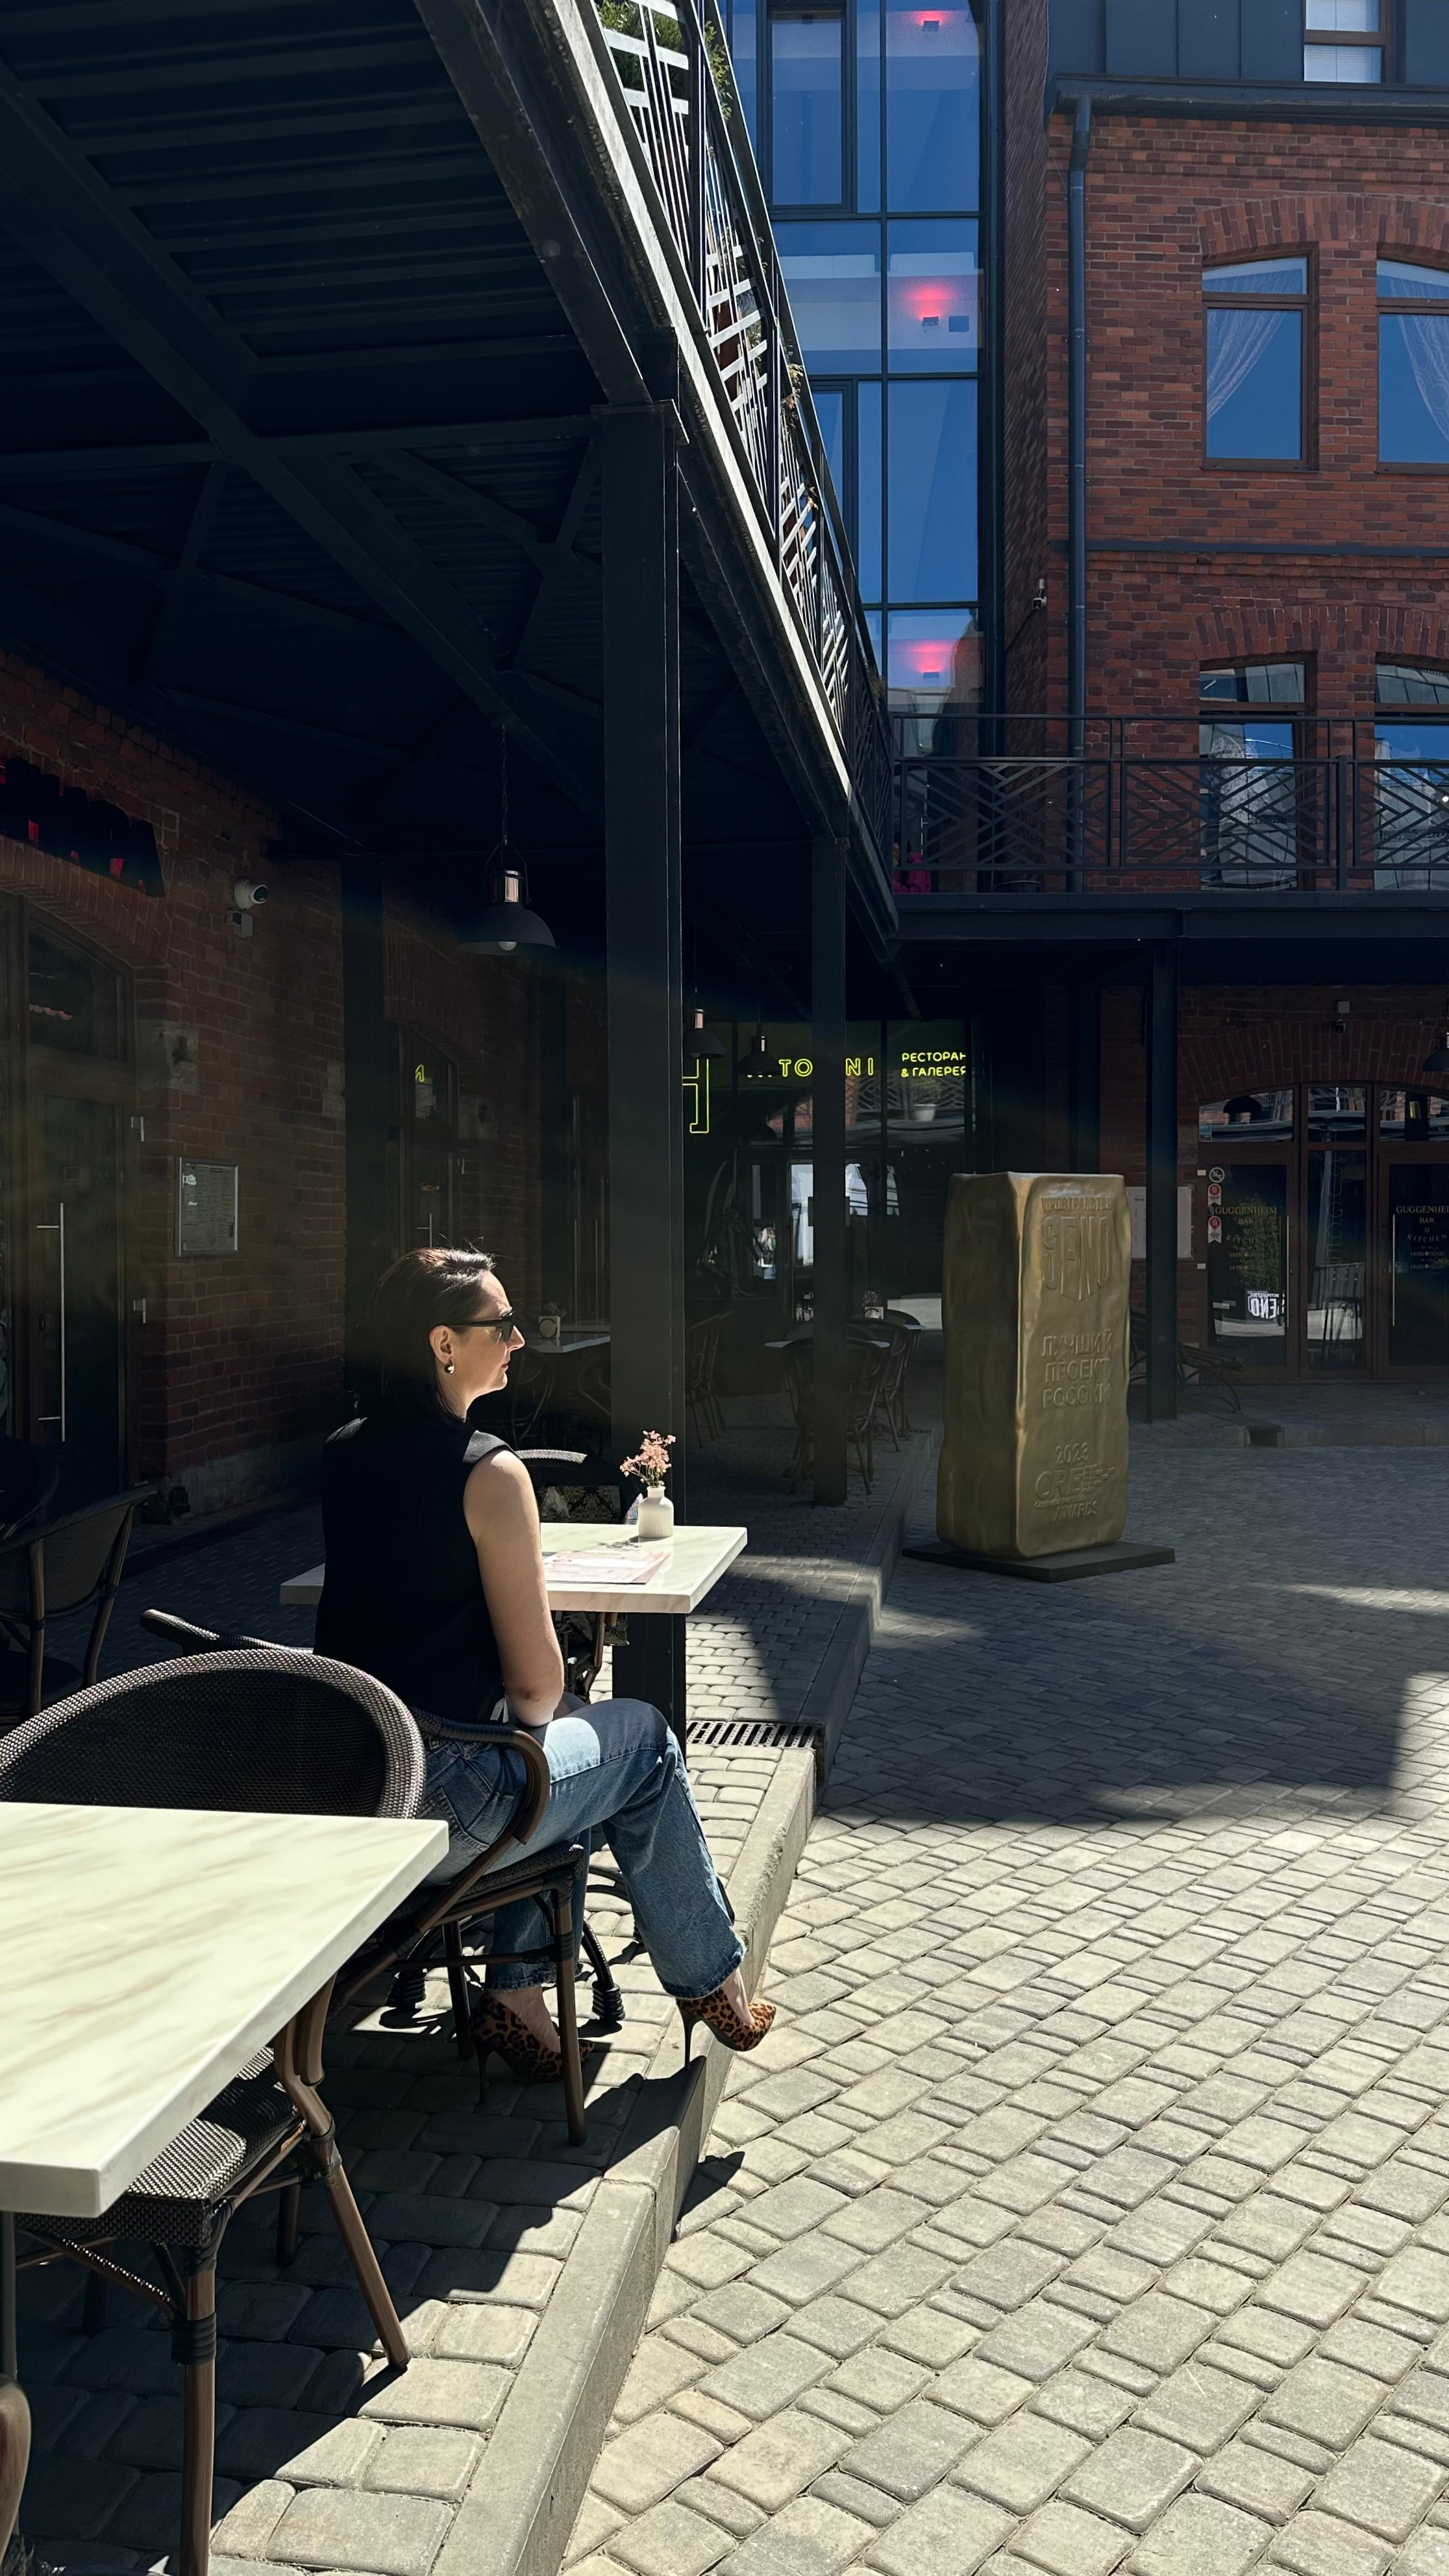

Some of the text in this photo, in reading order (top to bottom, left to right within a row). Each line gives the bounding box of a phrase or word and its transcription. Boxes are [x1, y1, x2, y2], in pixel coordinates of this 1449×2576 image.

[1215, 1206, 1276, 1215] GUGGENHEIM
[1407, 1233, 1447, 1243] KITCHEN
[1043, 1215, 1111, 1301] SENO
[1042, 1328, 1111, 1357] ЛУЧШИЙ
[1045, 1358, 1111, 1383] ПРОЕКТ
[1043, 1383, 1111, 1408] РОССИИ
[1055, 1443, 1089, 1465] 2023
